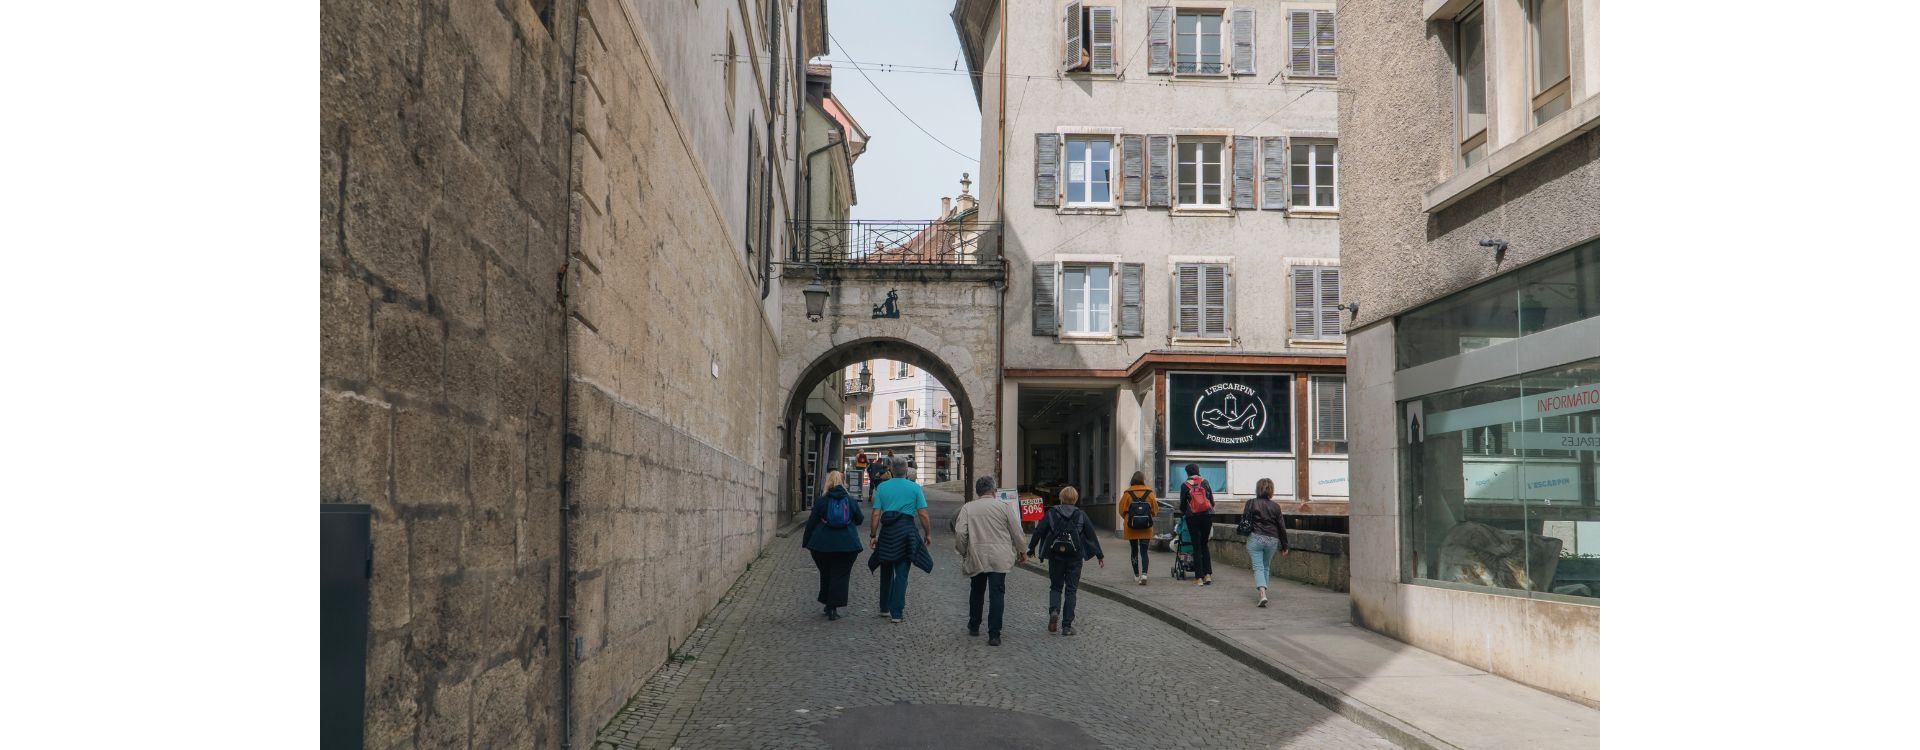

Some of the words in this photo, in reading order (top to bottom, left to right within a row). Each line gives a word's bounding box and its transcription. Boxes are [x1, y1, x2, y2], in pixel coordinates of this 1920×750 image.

[1205, 383, 1256, 396] L'ESCARPIN
[1537, 390, 1600, 412] INFORMATIO
[1206, 434, 1254, 443] PORRENTRUY
[1023, 504, 1042, 514] 50%
